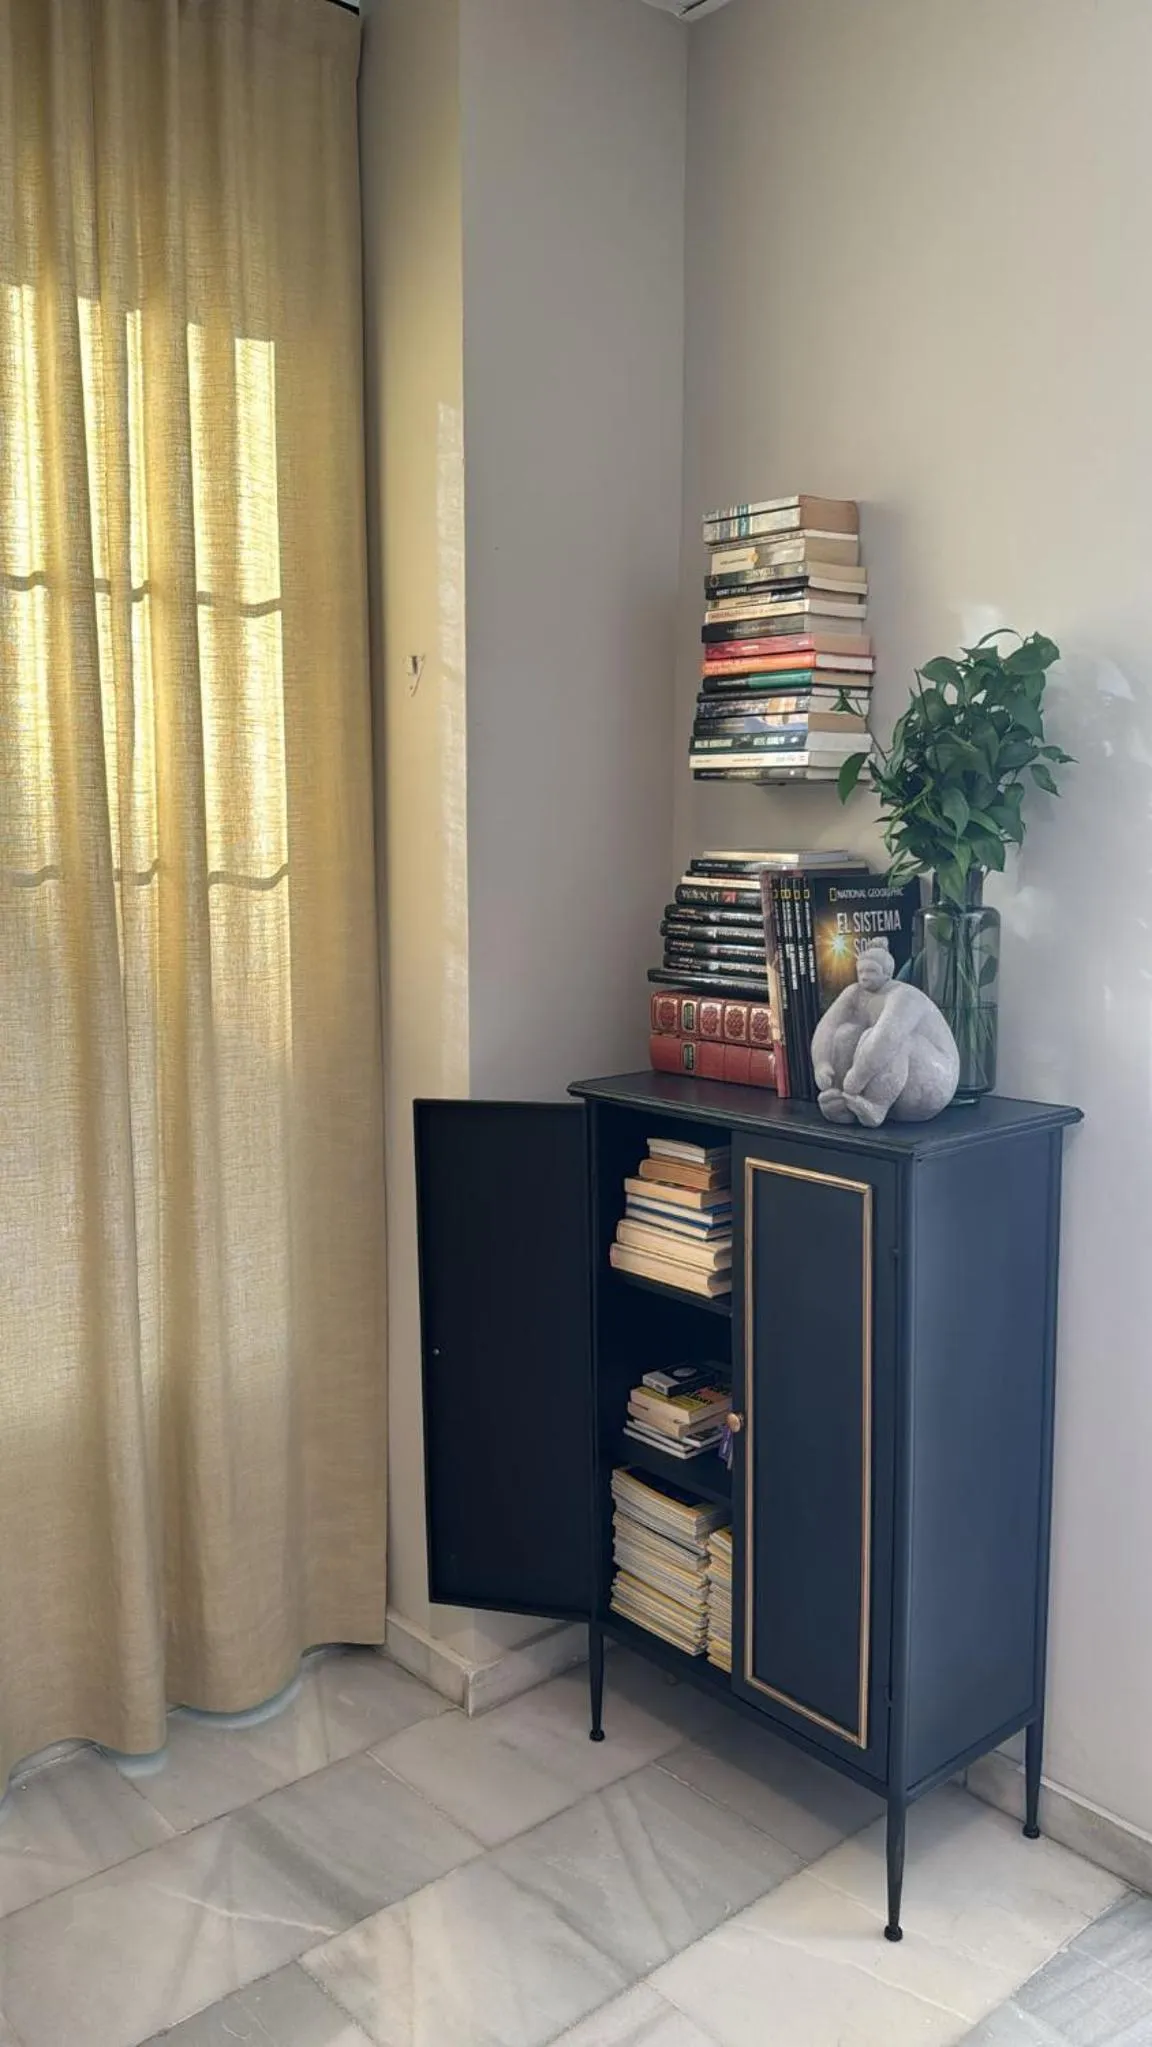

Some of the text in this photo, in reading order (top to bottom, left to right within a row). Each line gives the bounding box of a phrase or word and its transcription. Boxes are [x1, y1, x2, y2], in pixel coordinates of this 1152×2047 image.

[837, 889, 866, 899] NATIONAL
[837, 912, 852, 934] EL
[853, 910, 902, 932] SISTEMA
